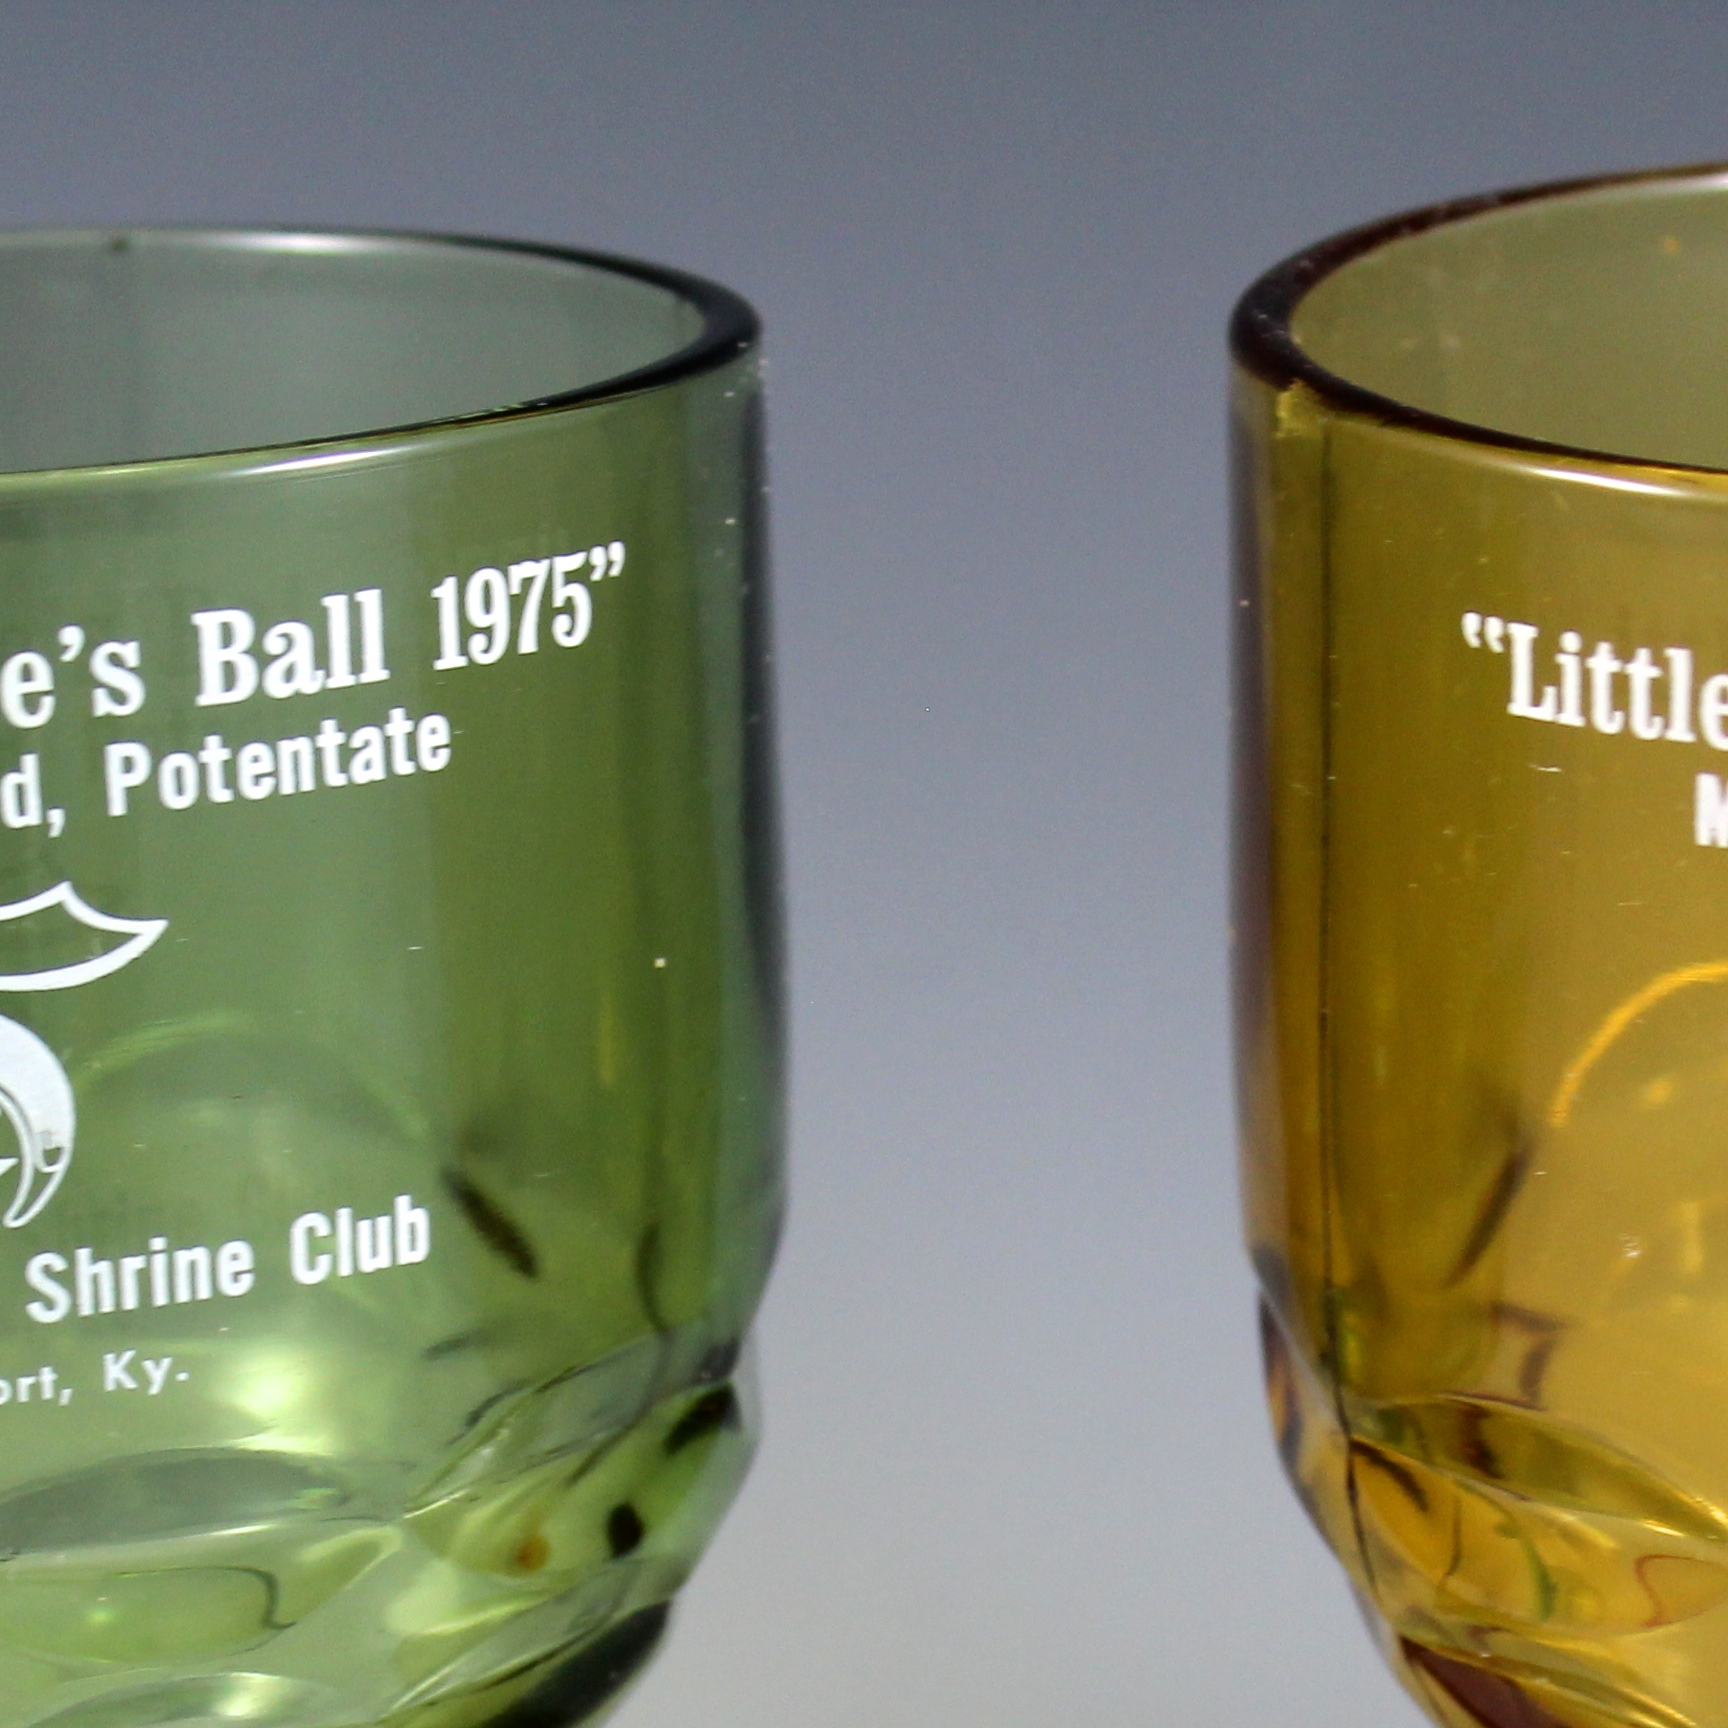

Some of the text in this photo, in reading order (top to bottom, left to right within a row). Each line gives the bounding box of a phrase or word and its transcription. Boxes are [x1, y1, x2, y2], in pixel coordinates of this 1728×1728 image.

[191, 589, 390, 707] Ball
[104, 707, 451, 817] Potentate
[24, 1236, 256, 1324] Shrine
[289, 1195, 431, 1285] Club
[102, 1349, 191, 1396] Ky.
